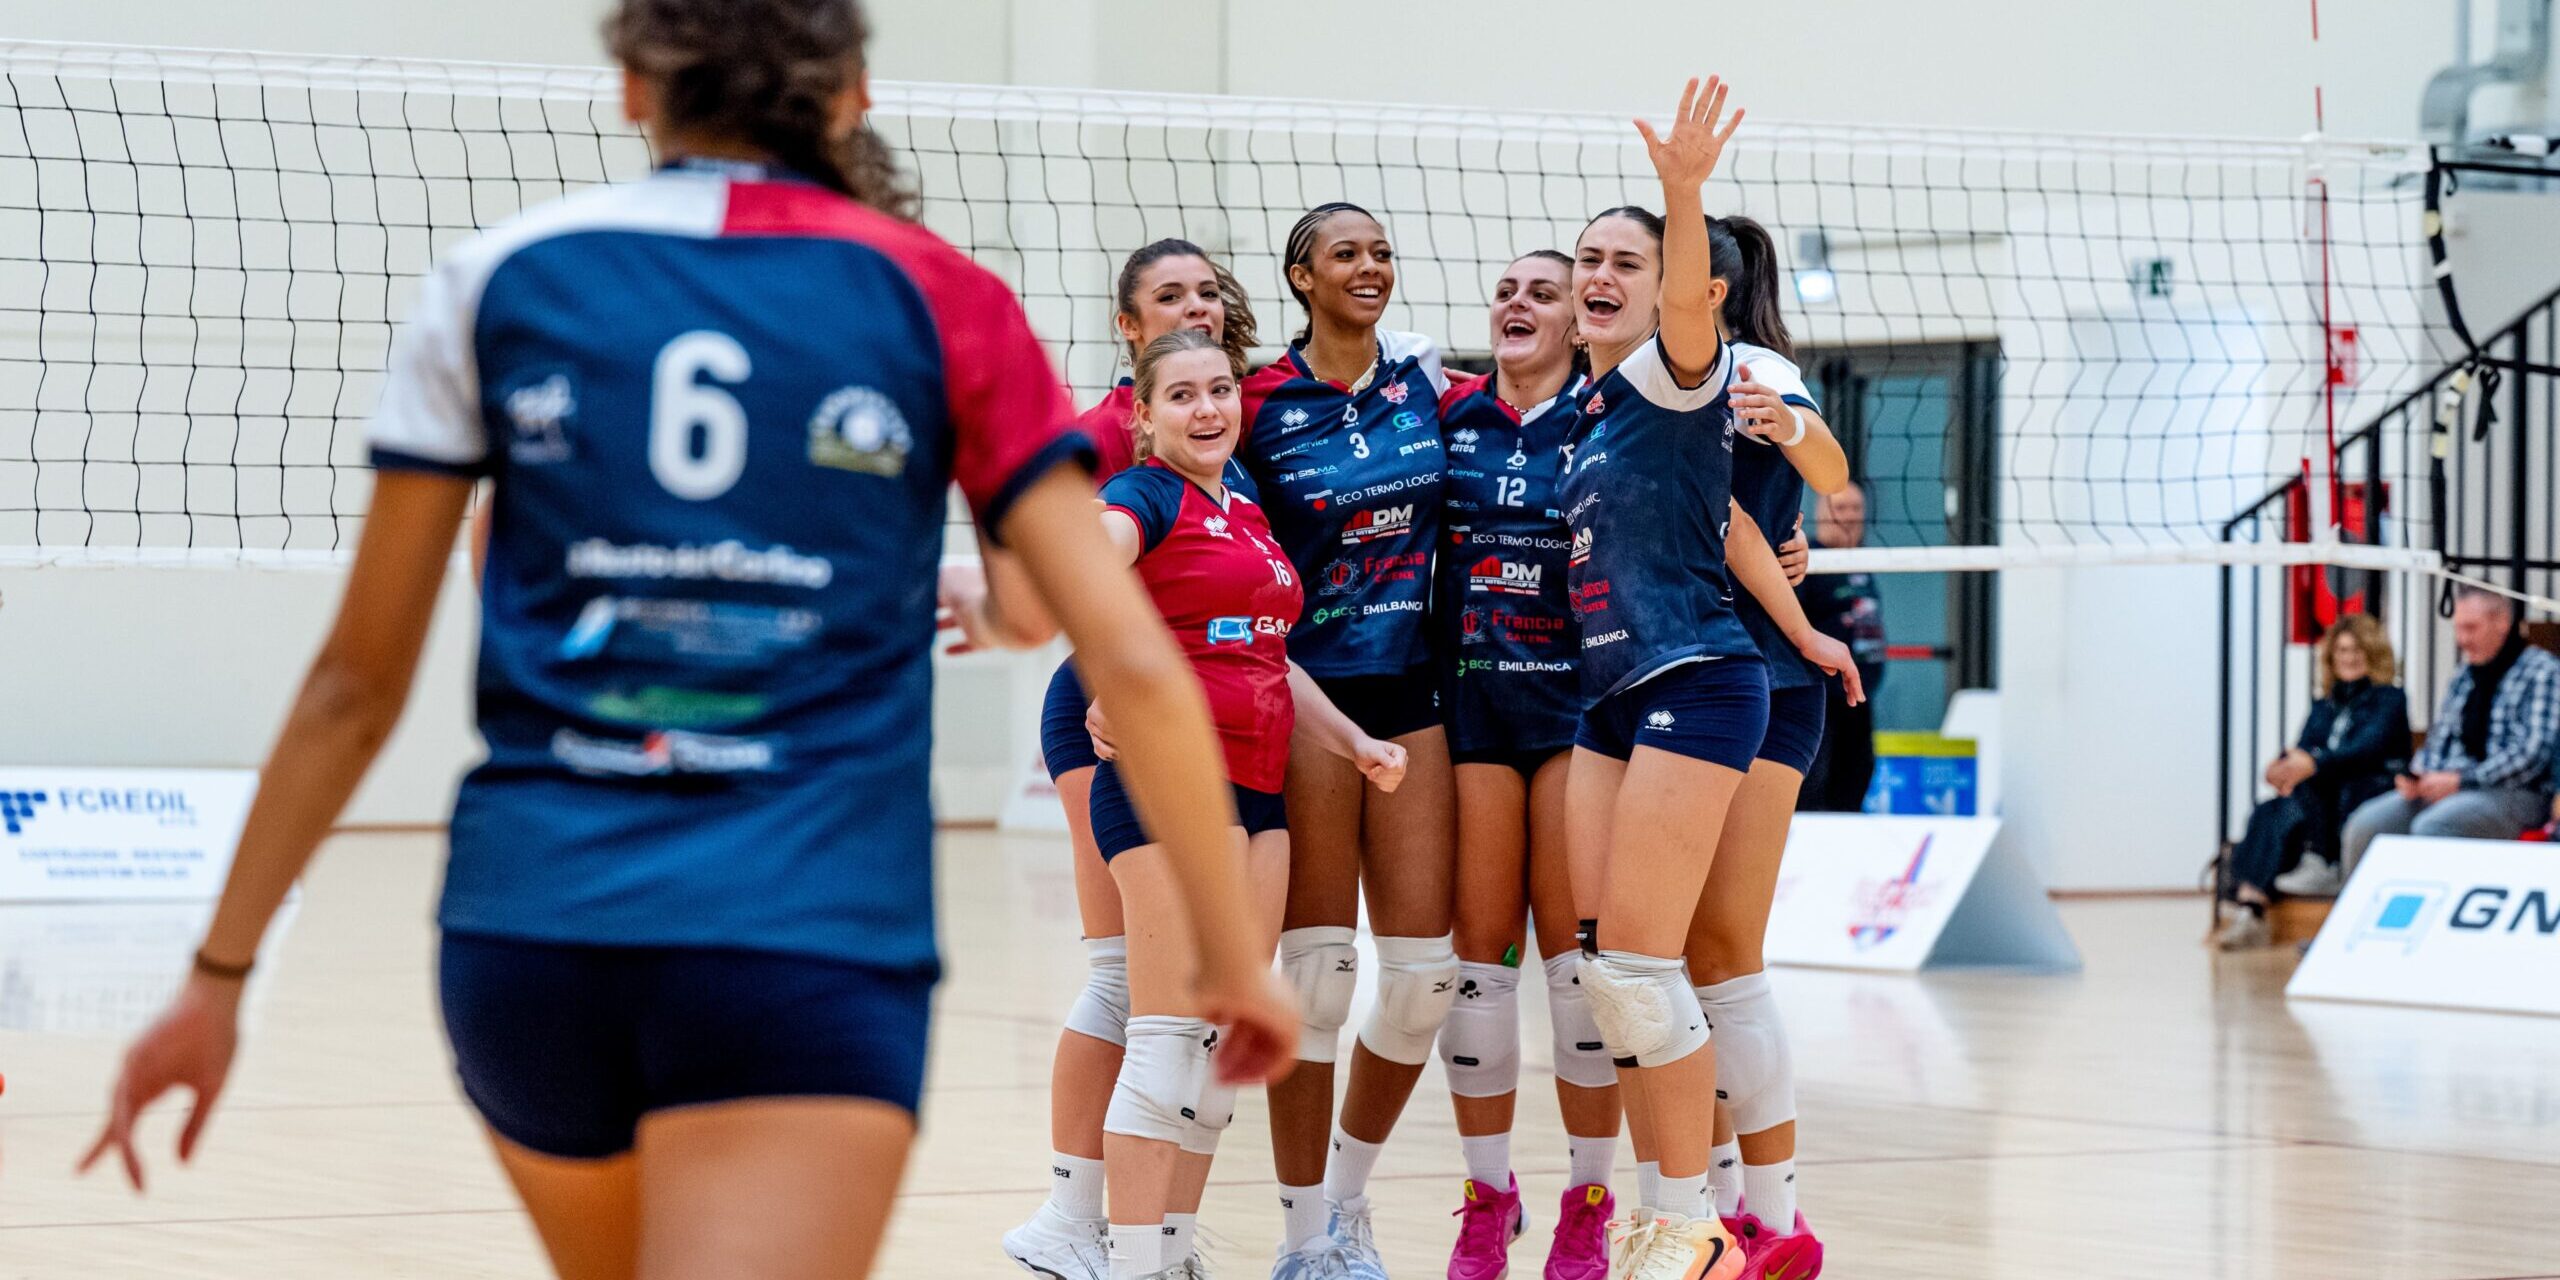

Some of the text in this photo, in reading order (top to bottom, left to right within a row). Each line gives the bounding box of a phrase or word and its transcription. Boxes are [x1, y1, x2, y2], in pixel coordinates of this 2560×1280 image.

[648, 329, 752, 500] 6
[1350, 432, 1370, 459] 3
[1448, 468, 1484, 479] etservice
[1336, 472, 1440, 506] ECO TERMO LOGIC
[1496, 476, 1527, 507] 12
[1373, 504, 1413, 526] DM
[1472, 534, 1571, 550] ECO TERMO LOGIC
[1266, 558, 1292, 587] 16
[1502, 562, 1542, 581] DM
[1331, 607, 1357, 618] BCC
[1492, 609, 1565, 630] Francia
[1585, 629, 1629, 649] EMILBANCA
[1469, 660, 1572, 672] BCC EMILBANCA
[59, 788, 194, 814] FCREDIL
